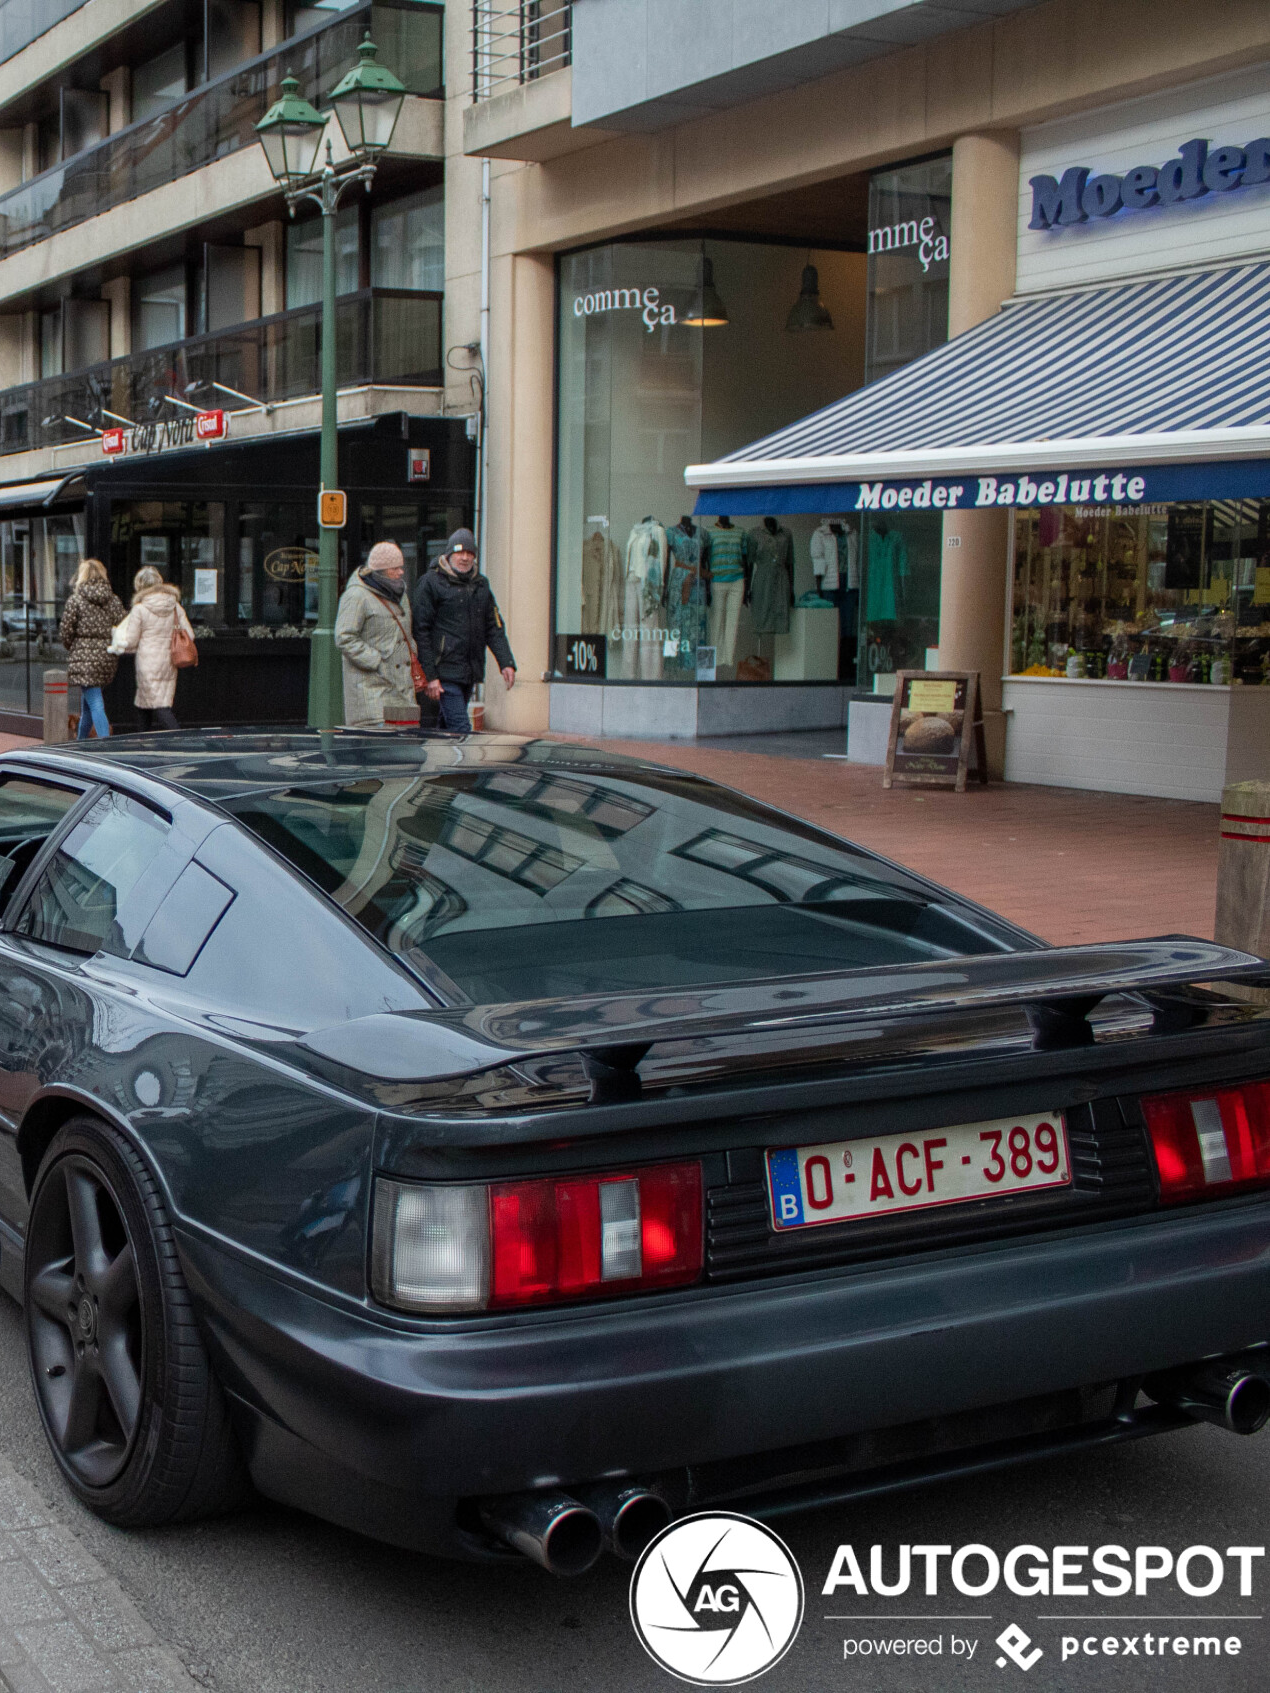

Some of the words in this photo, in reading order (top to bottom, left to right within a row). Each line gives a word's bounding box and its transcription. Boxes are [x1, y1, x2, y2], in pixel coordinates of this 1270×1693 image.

[1028, 137, 1270, 230] Moeder
[918, 238, 950, 272] ça
[573, 287, 660, 317] comme
[642, 304, 678, 333] ça
[854, 481, 964, 510] Moeder
[975, 473, 1145, 506] Babelutte
[1075, 506, 1111, 518] Moeder
[1115, 504, 1168, 516] Babelutte
[611, 627, 681, 641] comme
[567, 640, 598, 672] -10%
[780, 1194, 799, 1220] B
